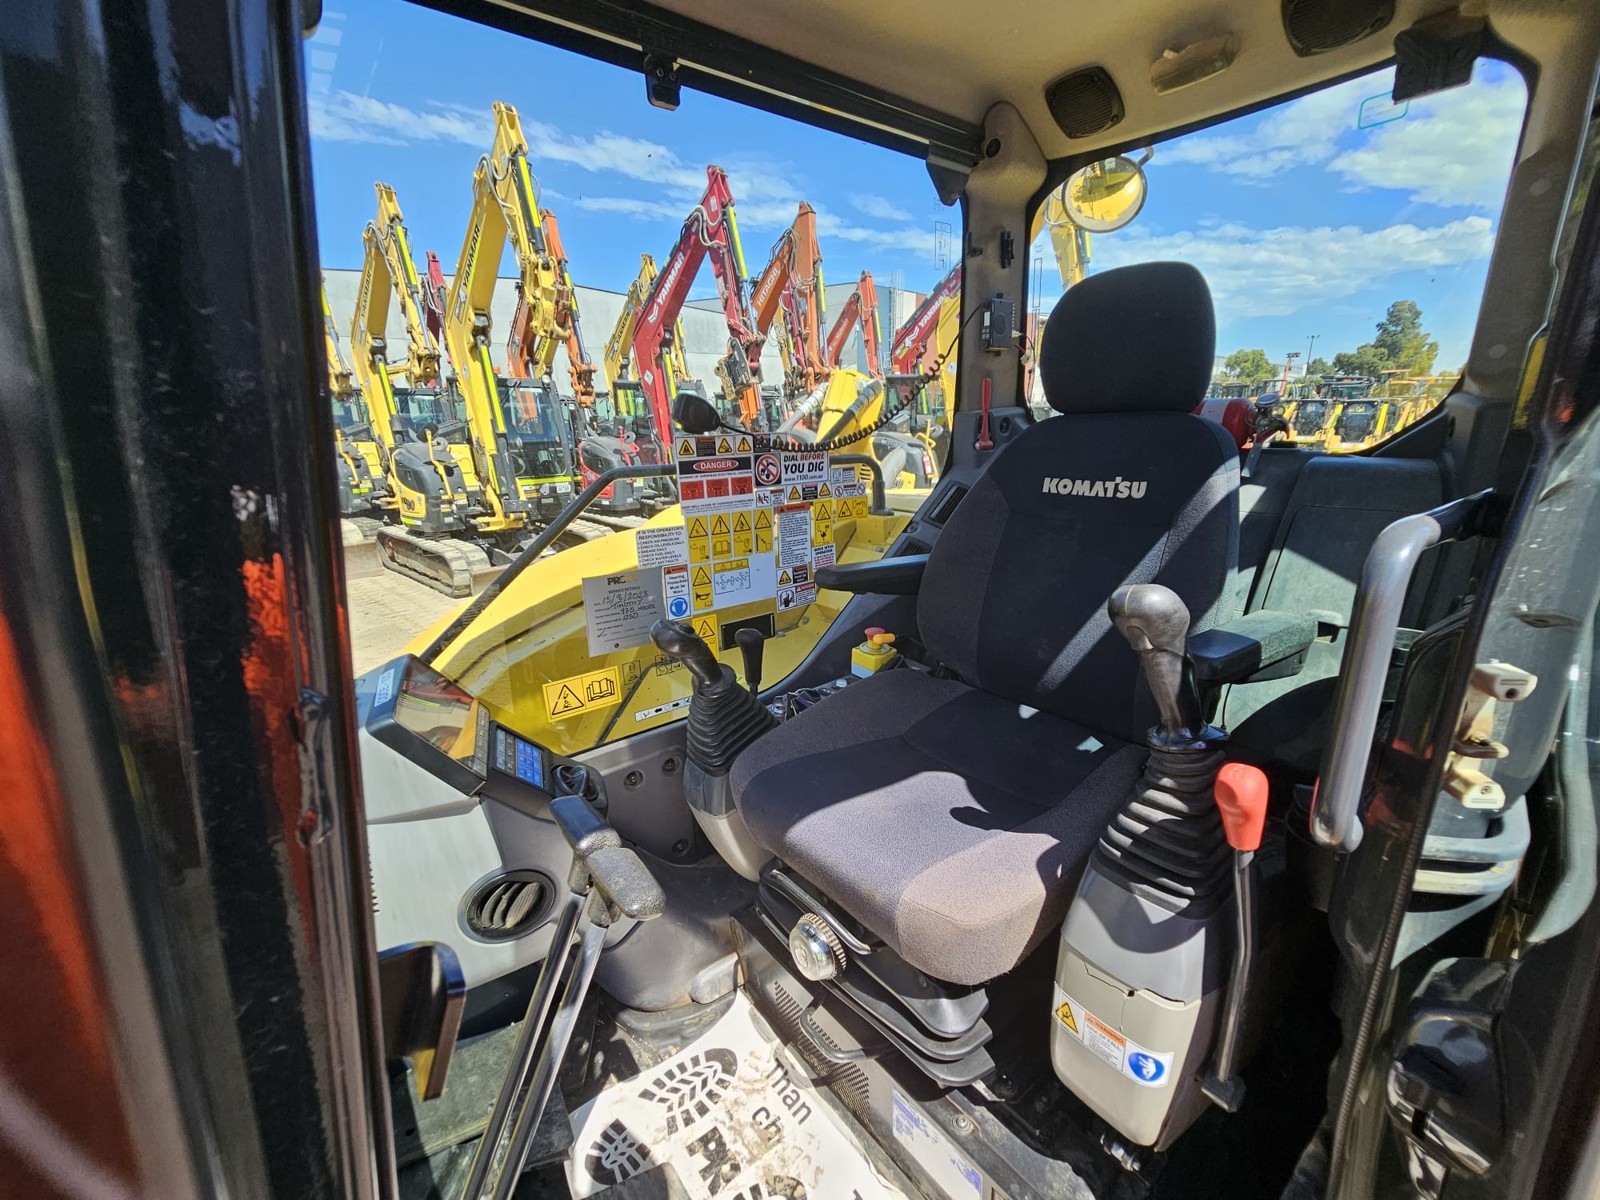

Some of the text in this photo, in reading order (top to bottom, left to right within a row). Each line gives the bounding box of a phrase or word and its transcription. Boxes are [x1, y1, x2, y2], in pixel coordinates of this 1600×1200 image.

[463, 224, 480, 288] YANMAR
[657, 252, 685, 304] YANMAR
[757, 268, 780, 306] HITACHI
[700, 461, 732, 469] DANGER
[784, 453, 825, 462] DIAL BEFORE
[784, 462, 824, 474] YOU DIG
[1042, 477, 1148, 499] KOMATSU
[607, 575, 626, 585] PRC
